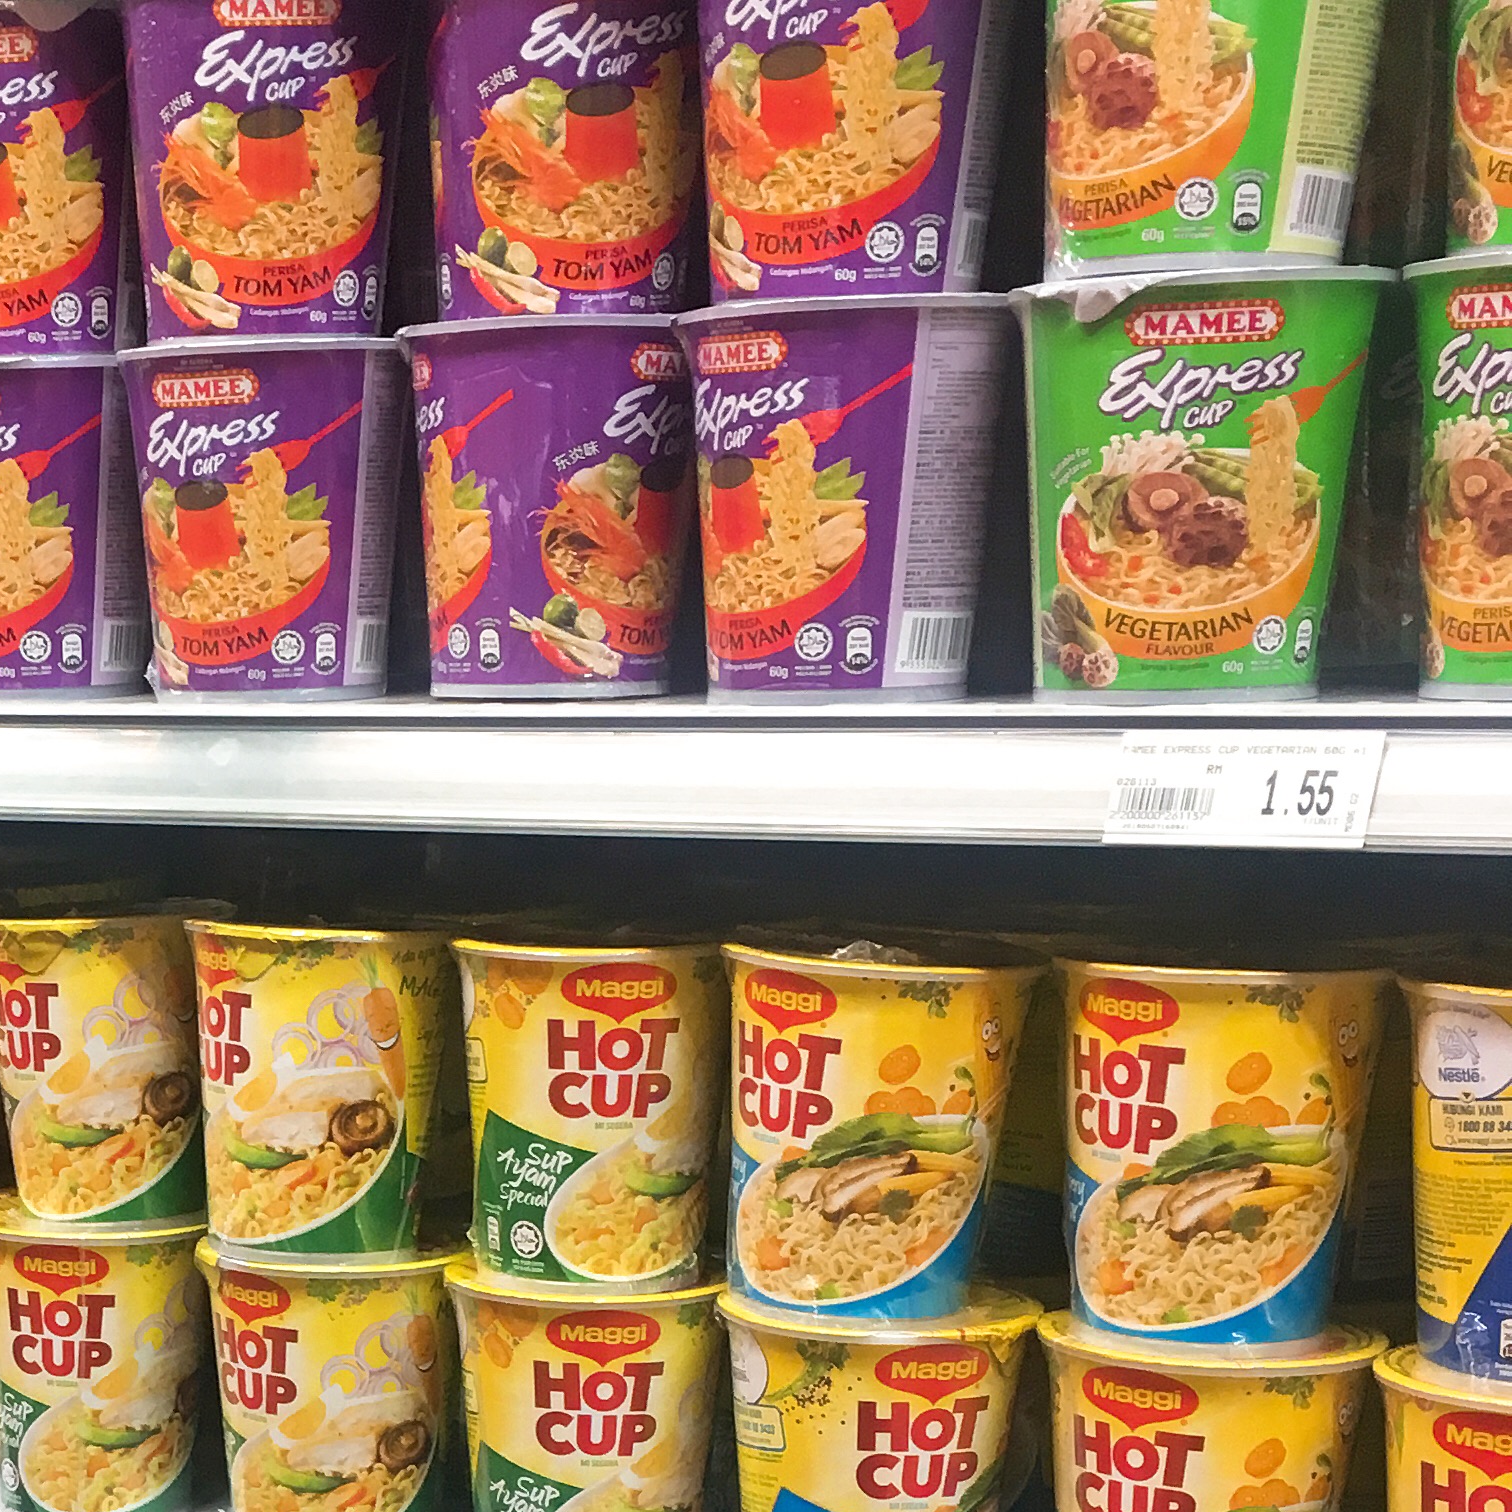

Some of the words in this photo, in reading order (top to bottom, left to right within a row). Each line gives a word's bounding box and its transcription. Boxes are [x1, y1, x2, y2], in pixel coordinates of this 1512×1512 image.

[194, 30, 359, 101] Express
[477, 64, 518, 100] 东炎味
[754, 231, 803, 255] TOM
[809, 219, 864, 251] YAM
[233, 276, 284, 298] TOM
[285, 267, 332, 297] YAM
[553, 260, 604, 281] TOM
[609, 250, 653, 279] YAM
[834, 269, 857, 282] 60g
[1144, 308, 1268, 338] MAMEE
[161, 378, 248, 400] MAMEE
[1098, 346, 1305, 429] Express
[552, 440, 600, 473] 东炎味
[748, 619, 793, 646] YAM
[1103, 607, 1254, 642] VEGETARIAN
[1145, 641, 1215, 657] FLAVOUR
[1164, 745, 1212, 755] EXPRESS
[1218, 745, 1240, 755] CUP
[1247, 745, 1318, 755] VEGETARIAN
[1261, 770, 1338, 816] 1.55
[547, 1017, 681, 1071] HOT
[1073, 1034, 1186, 1104] HOT
[548, 1072, 672, 1119] CUP
[1075, 1093, 1179, 1155] CUP
[526, 1142, 573, 1173] Sup
[499, 1182, 550, 1208] Special
[7, 1287, 117, 1339] HOT
[558, 1321, 647, 1345] Maggi
[11, 1336, 113, 1380] CUP
[890, 1357, 979, 1380] Maggi
[533, 1360, 665, 1412] HOT
[1093, 1378, 1182, 1411] Maggi
[535, 1411, 657, 1456] CUP
[856, 1395, 990, 1452] HOT
[1073, 1414, 1205, 1488] HOT
[516, 1476, 560, 1504] Sup
[855, 1451, 978, 1500] CUP
